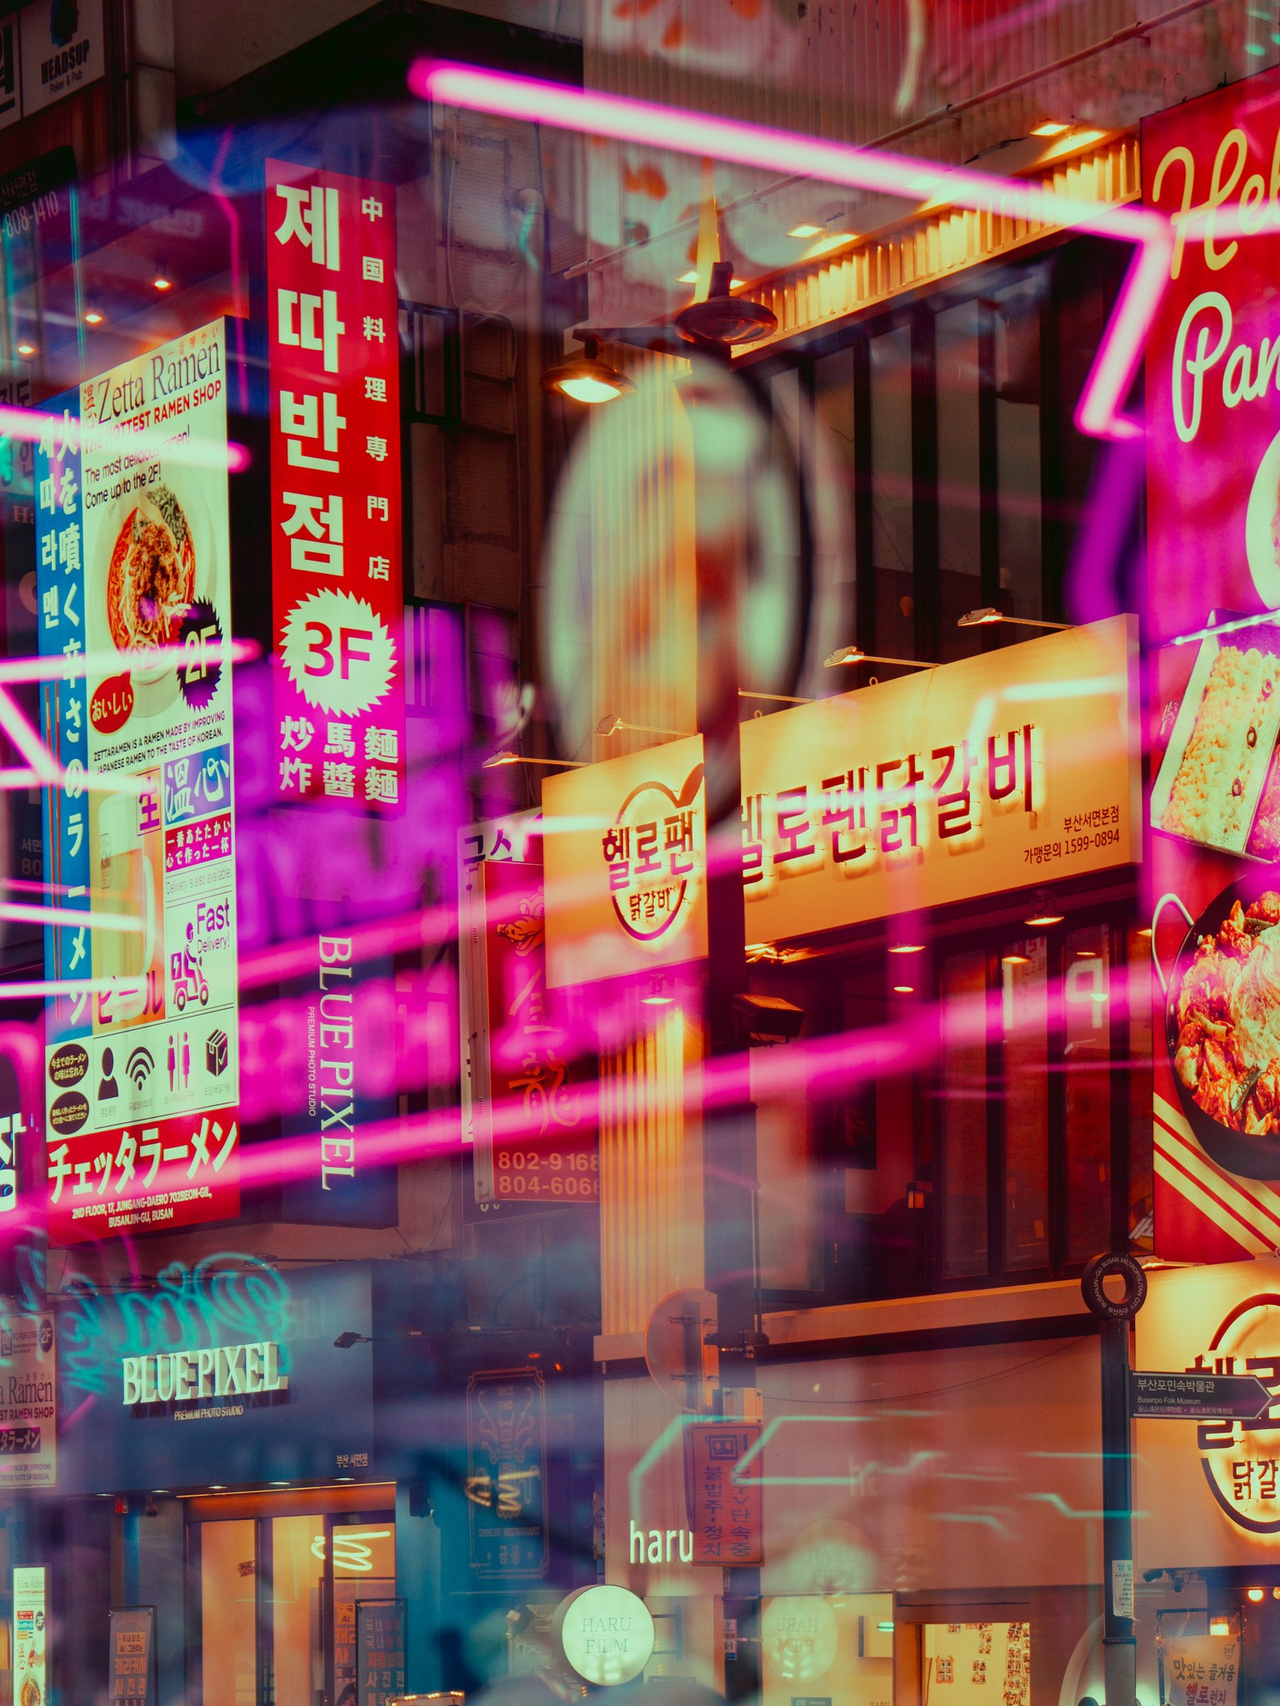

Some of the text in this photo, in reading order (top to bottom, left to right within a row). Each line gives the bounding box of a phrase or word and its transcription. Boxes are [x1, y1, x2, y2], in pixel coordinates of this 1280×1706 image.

[41, 39, 90, 85] HEADSUP
[98, 342, 221, 424] Zetta Ramen
[275, 184, 345, 577] 제따반점
[360, 197, 390, 582] 中国料理専門店
[106, 410, 151, 441] HOTTEST
[153, 394, 191, 425] RAMEN
[193, 379, 222, 408] SHOP
[85, 466, 101, 486] The
[102, 457, 122, 478] most
[85, 461, 162, 511] Come up to the 2F!
[185, 625, 216, 684] 2F
[303, 621, 373, 681] 3F
[91, 691, 133, 723] おいしい
[94, 742, 131, 762] ZETTARAMEN
[144, 731, 164, 746] RAMEN
[165, 726, 182, 739] MADE
[183, 722, 191, 733] BY
[192, 711, 225, 729] IMPROVING
[125, 752, 146, 766] RAMEN
[146, 749, 155, 759] TO
[156, 744, 168, 756] THE
[168, 738, 187, 752] TASTE
[187, 735, 196, 746] OF
[197, 727, 223, 743] KOREAN.
[167, 820, 231, 848] 一番あたたかい
[1063, 804, 1119, 834] 부산서면본점
[166, 836, 229, 869] 心で作った一杯
[602, 811, 695, 891] 헬로팬
[1024, 828, 1120, 864] 가맹문의 1599-0894
[167, 877, 187, 894] Delivery
[195, 872, 205, 886] also
[197, 897, 230, 934] Fast
[629, 887, 673, 922] 닭갈비
[197, 931, 230, 954] Delivery!
[308, 1006, 316, 1117] PREMIUM PHOTO STUDIO
[319, 934, 354, 1191] BLUE PIXEL
[48, 1117, 237, 1204] チェッタラーメン
[72, 1206, 84, 1219] 2ND
[85, 1202, 107, 1217] FLOOR,
[116, 1194, 168, 1212] JUNGANG-DAERO
[109, 1207, 173, 1227] BUSANJIN-GU, BUSAN
[41, 1327, 53, 1344] 2F
[8, 1376, 53, 1406] Ramen
[1137, 1379, 1215, 1393] 부산포민속박물관
[1137, 1395, 1201, 1405] Busanpo Folk Museum
[9, 1406, 54, 1421] RAMEN SHOP
[174, 1405, 244, 1421] PREMIUM PHOTO STUDIO
[630, 1520, 693, 1564] haru
[582, 1617, 632, 1633] HARU
[586, 1639, 628, 1654] FILM
